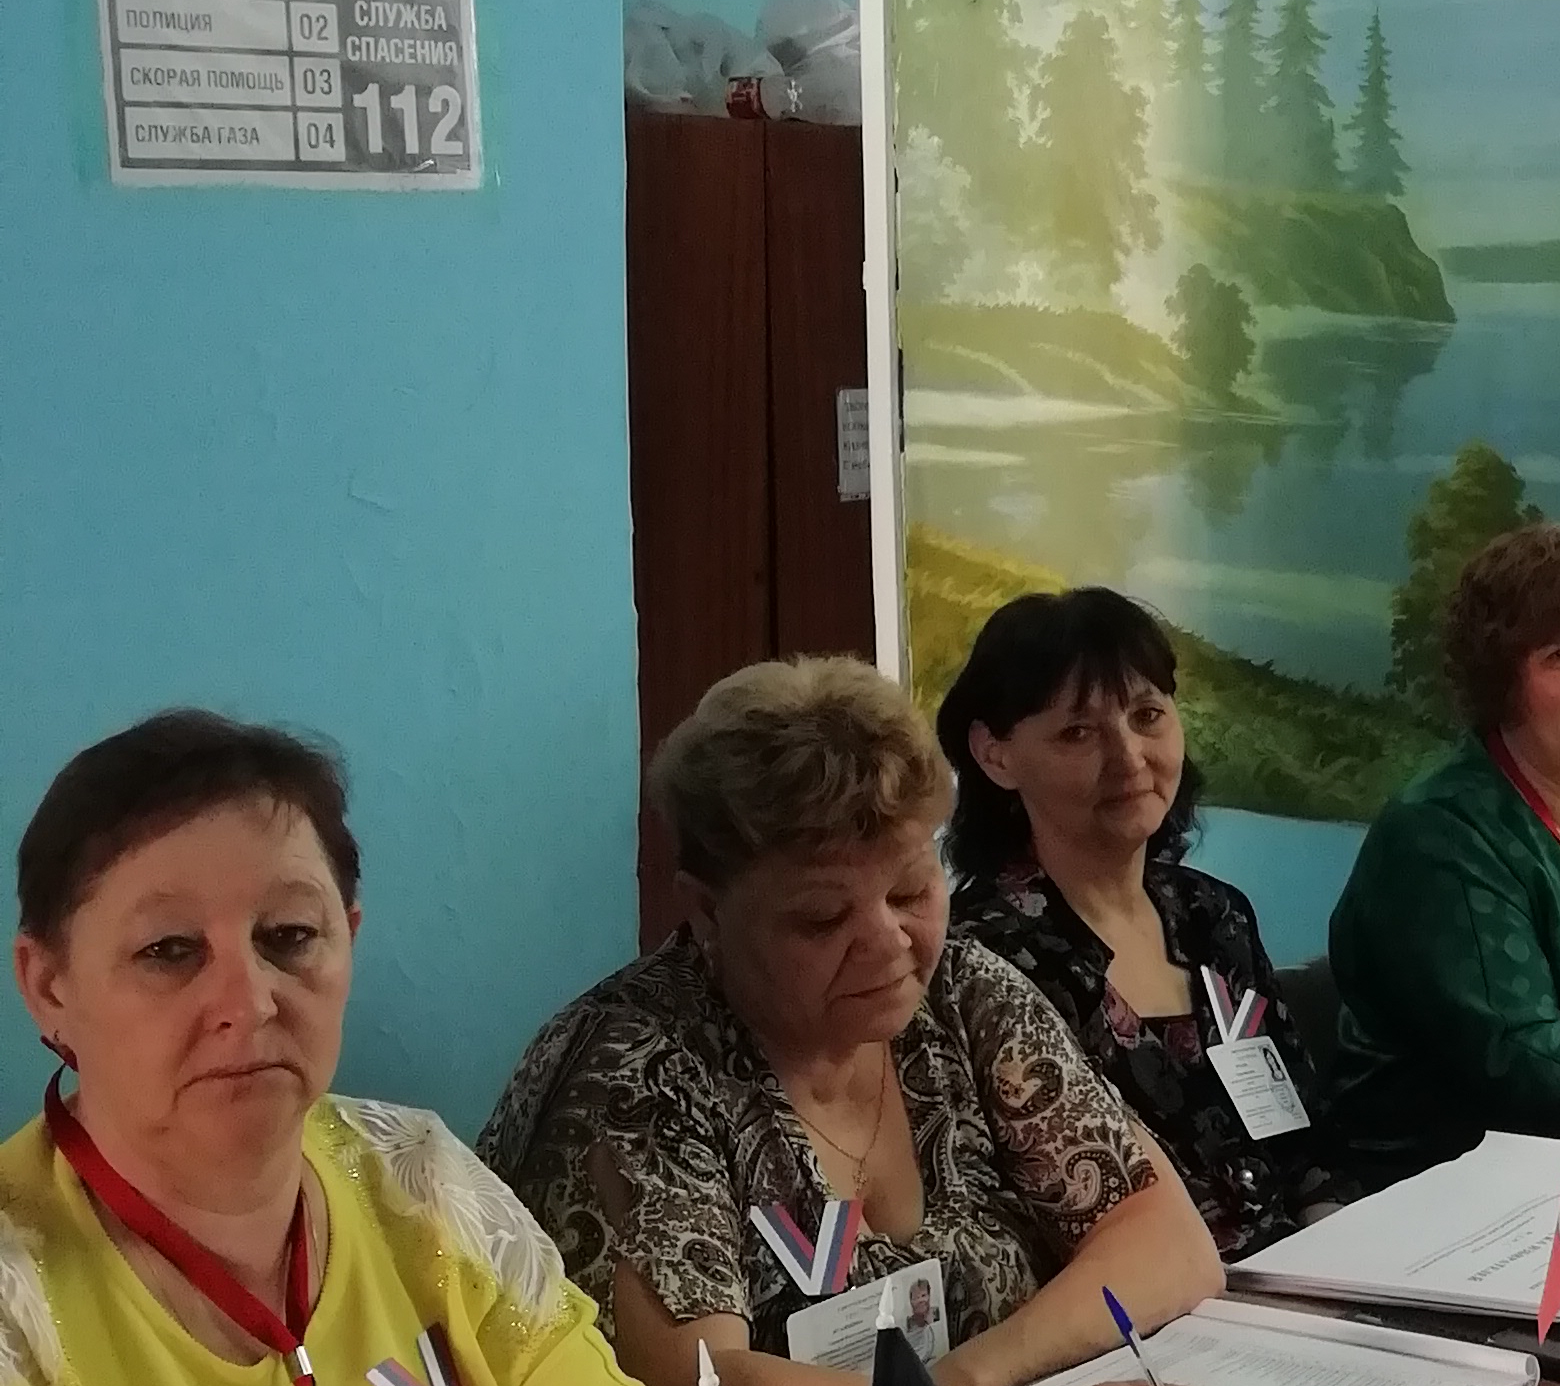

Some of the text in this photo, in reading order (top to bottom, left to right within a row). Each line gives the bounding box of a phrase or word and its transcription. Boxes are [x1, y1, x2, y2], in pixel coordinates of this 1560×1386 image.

[126, 9, 329, 41] ПОЛИЦИЯ 02
[354, 0, 447, 32] СЛУЖБА
[346, 35, 459, 66] СПАСЕНИЯ
[130, 66, 332, 95] СКОРАЯ ПОМОЩЬ 03
[352, 81, 464, 156] 112
[135, 122, 336, 150] СЛУЖБА ГАЗА 04
